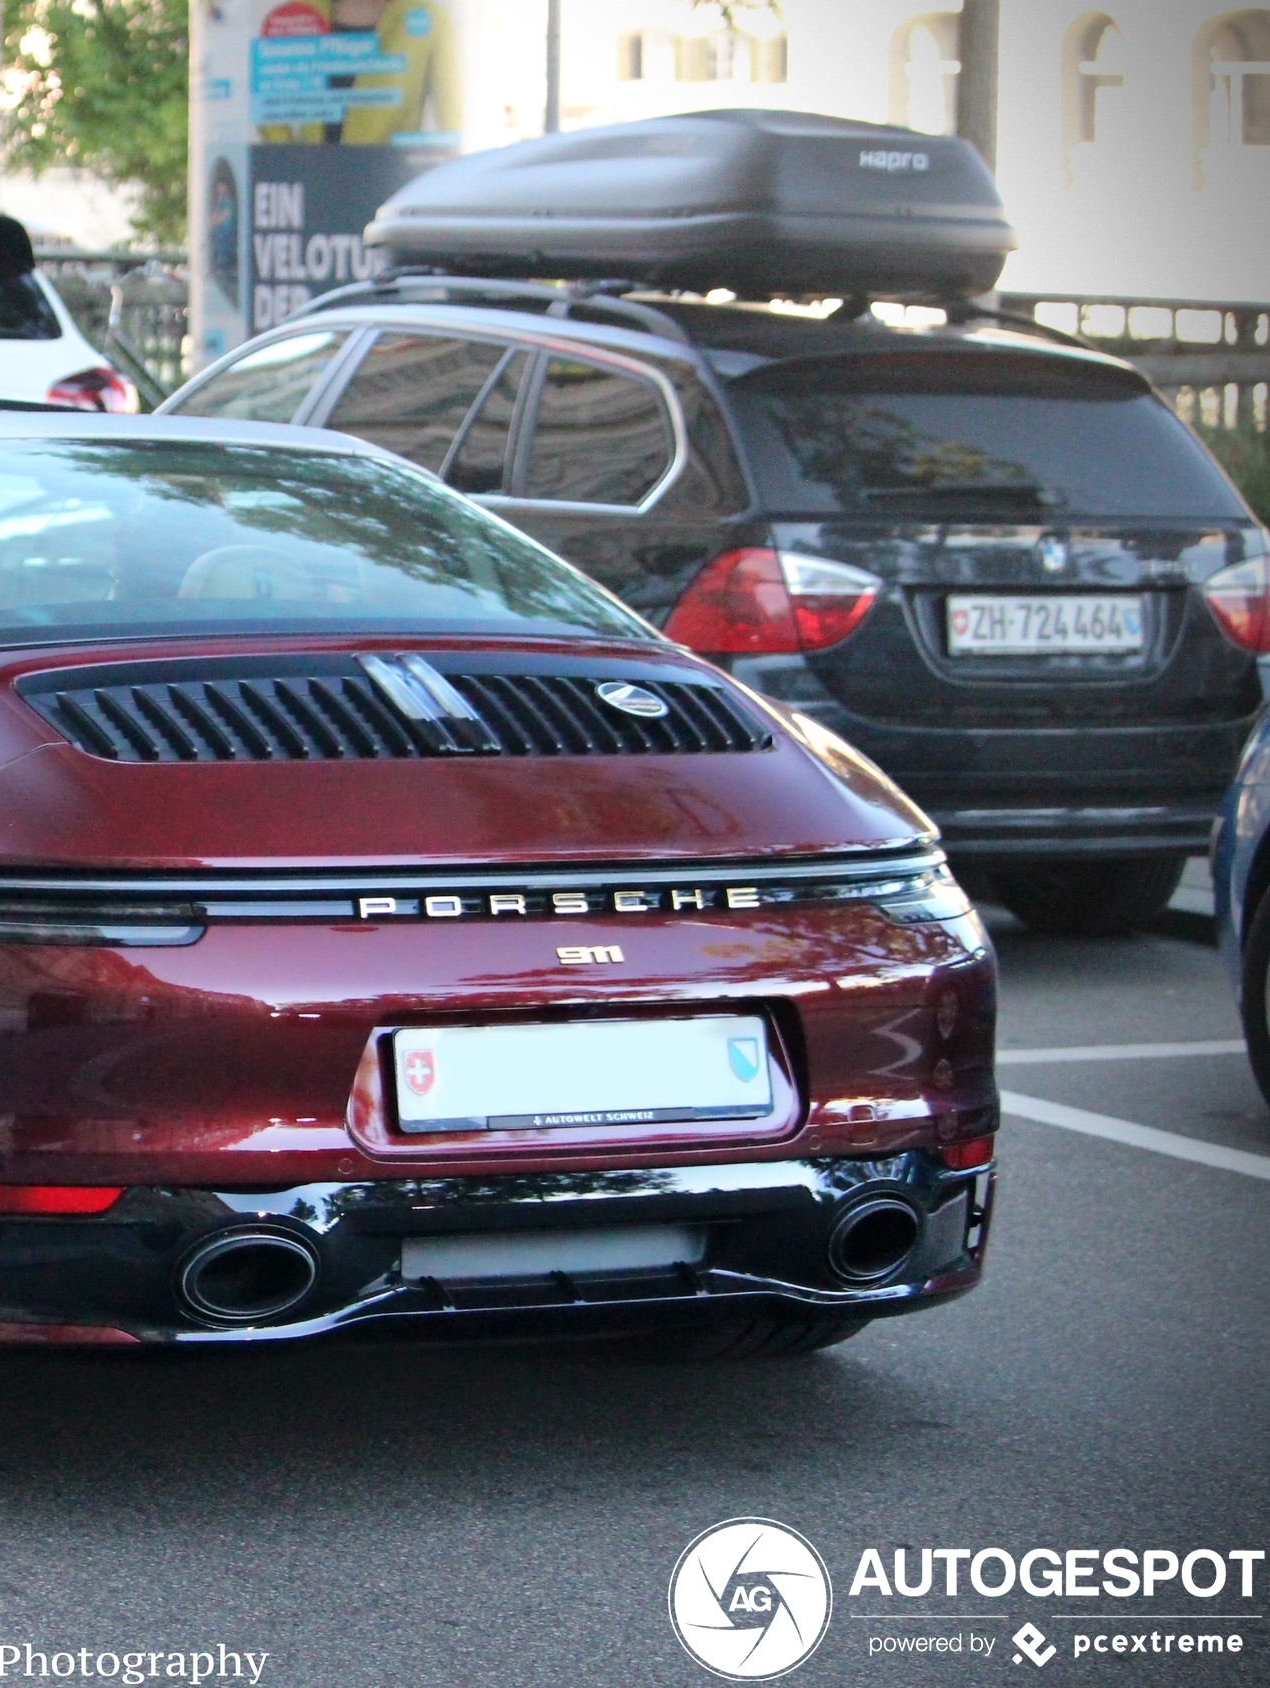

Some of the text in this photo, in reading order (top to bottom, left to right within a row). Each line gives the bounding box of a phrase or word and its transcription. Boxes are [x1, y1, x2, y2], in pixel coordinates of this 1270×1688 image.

[253, 181, 306, 229] EIN
[359, 887, 762, 919] PORSCHE
[556, 945, 625, 966] 911
[545, 1111, 655, 1124] AUTOWELT SCHWEIZ
